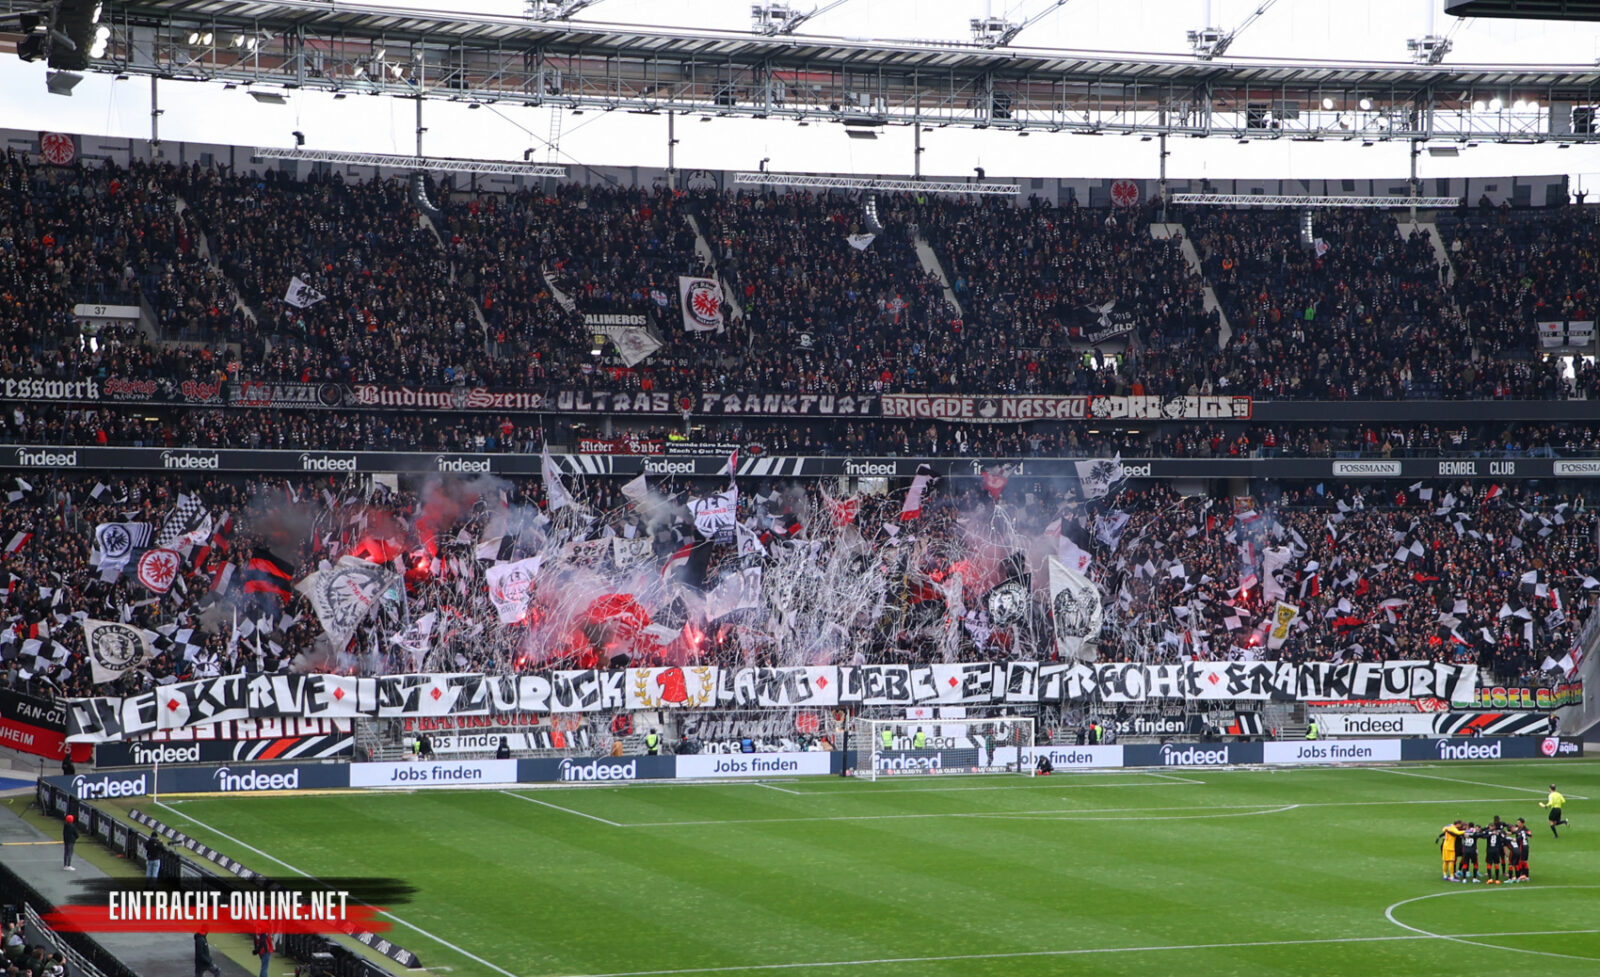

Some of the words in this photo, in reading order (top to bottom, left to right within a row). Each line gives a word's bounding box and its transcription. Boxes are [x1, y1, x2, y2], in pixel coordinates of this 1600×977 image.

[94, 305, 107, 316] 37
[353, 384, 453, 408] Binding
[467, 386, 543, 409] Szene
[557, 391, 670, 411] ULTRAS
[702, 393, 876, 414] FRANKFURT
[882, 399, 974, 418] BRIGADE
[1001, 399, 1086, 418] NASSAU
[18, 450, 77, 466] indeed
[163, 453, 219, 469] indeed
[302, 456, 357, 471] indeed
[437, 457, 491, 473] indeed
[643, 459, 696, 474] indeed
[845, 461, 897, 475] indeed
[1339, 464, 1396, 473] POSSMANN
[1438, 461, 1478, 475] BEMBEL
[1489, 461, 1516, 475] CLUB
[176, 674, 330, 727] KURVE
[1225, 660, 1460, 701] FRANKFURT
[1134, 717, 1185, 734] finden
[1344, 716, 1404, 734] indeed
[456, 733, 498, 748] finde
[134, 742, 200, 764] indeed
[1049, 750, 1093, 764] finden
[1164, 745, 1229, 765] indeed
[1297, 745, 1327, 759] Jobs
[1330, 744, 1372, 758] finden
[1440, 740, 1502, 760] indeed
[390, 766, 428, 782] Jobs
[431, 765, 483, 781] finden
[563, 760, 637, 781] indeed
[713, 759, 746, 773] Jobs
[751, 758, 799, 772] finden
[76, 773, 147, 799] indeed
[219, 768, 299, 791] indeed
